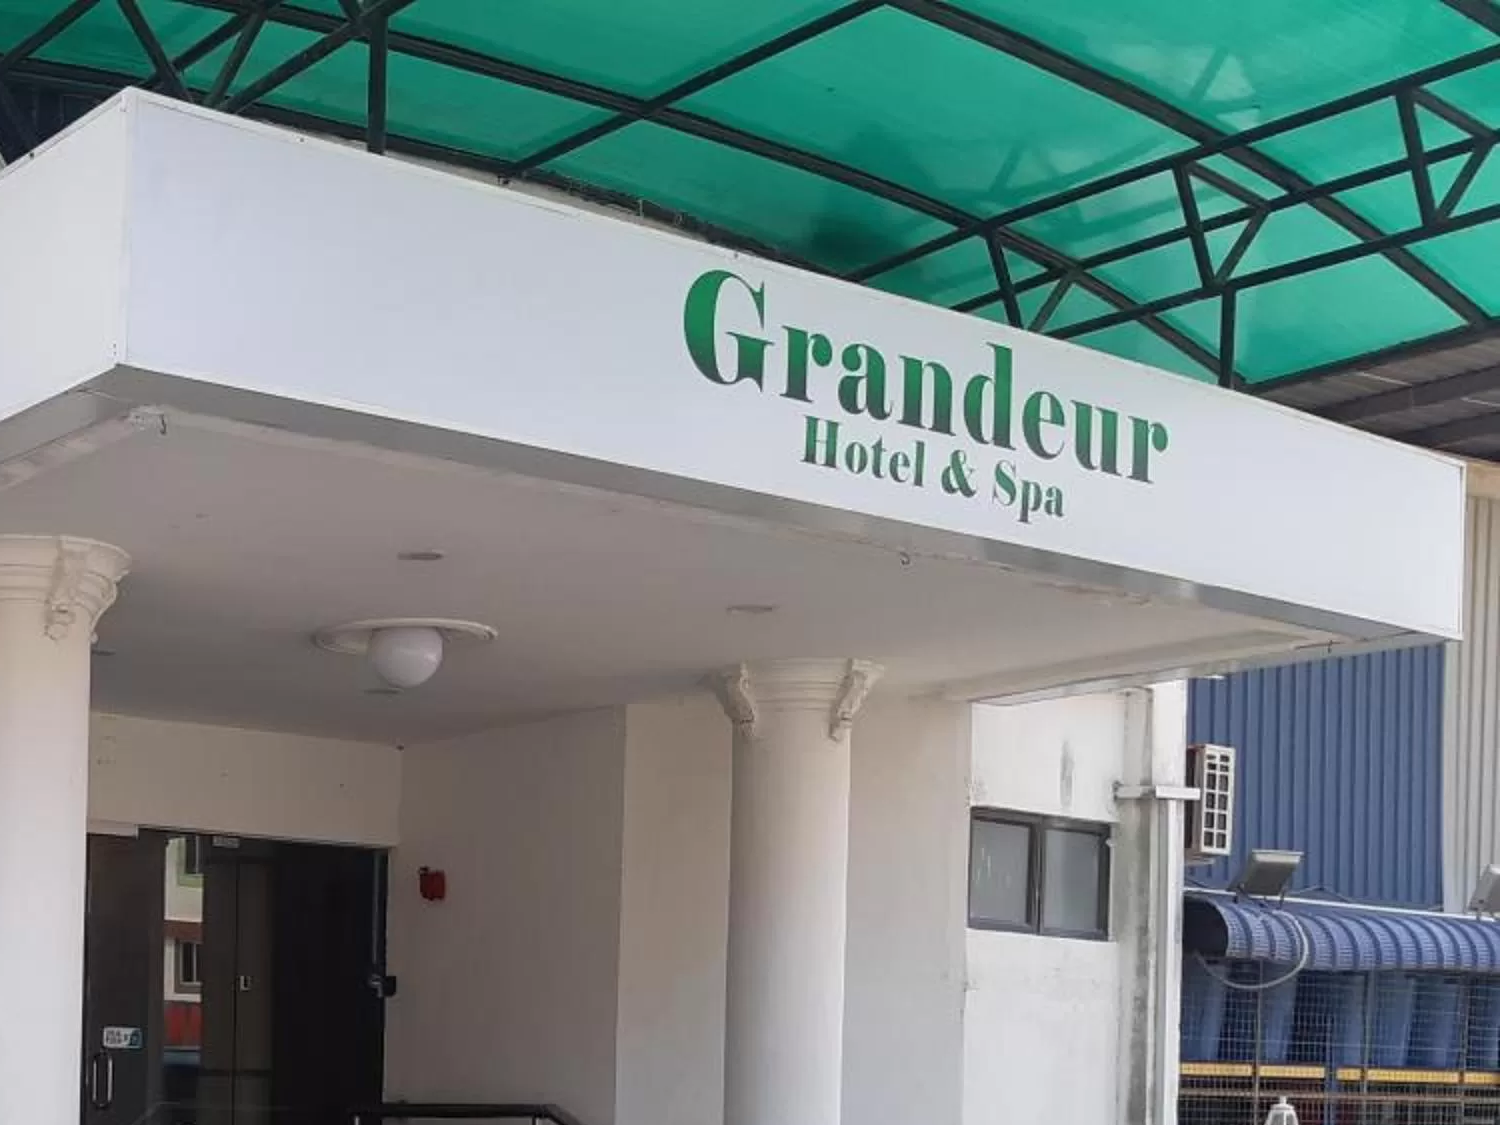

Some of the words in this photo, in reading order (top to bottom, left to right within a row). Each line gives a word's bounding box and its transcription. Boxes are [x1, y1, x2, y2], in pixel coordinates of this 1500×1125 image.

[682, 268, 1170, 485] Grandeur
[800, 414, 926, 489] Hotel
[940, 449, 978, 500] &
[991, 460, 1065, 525] Spa
